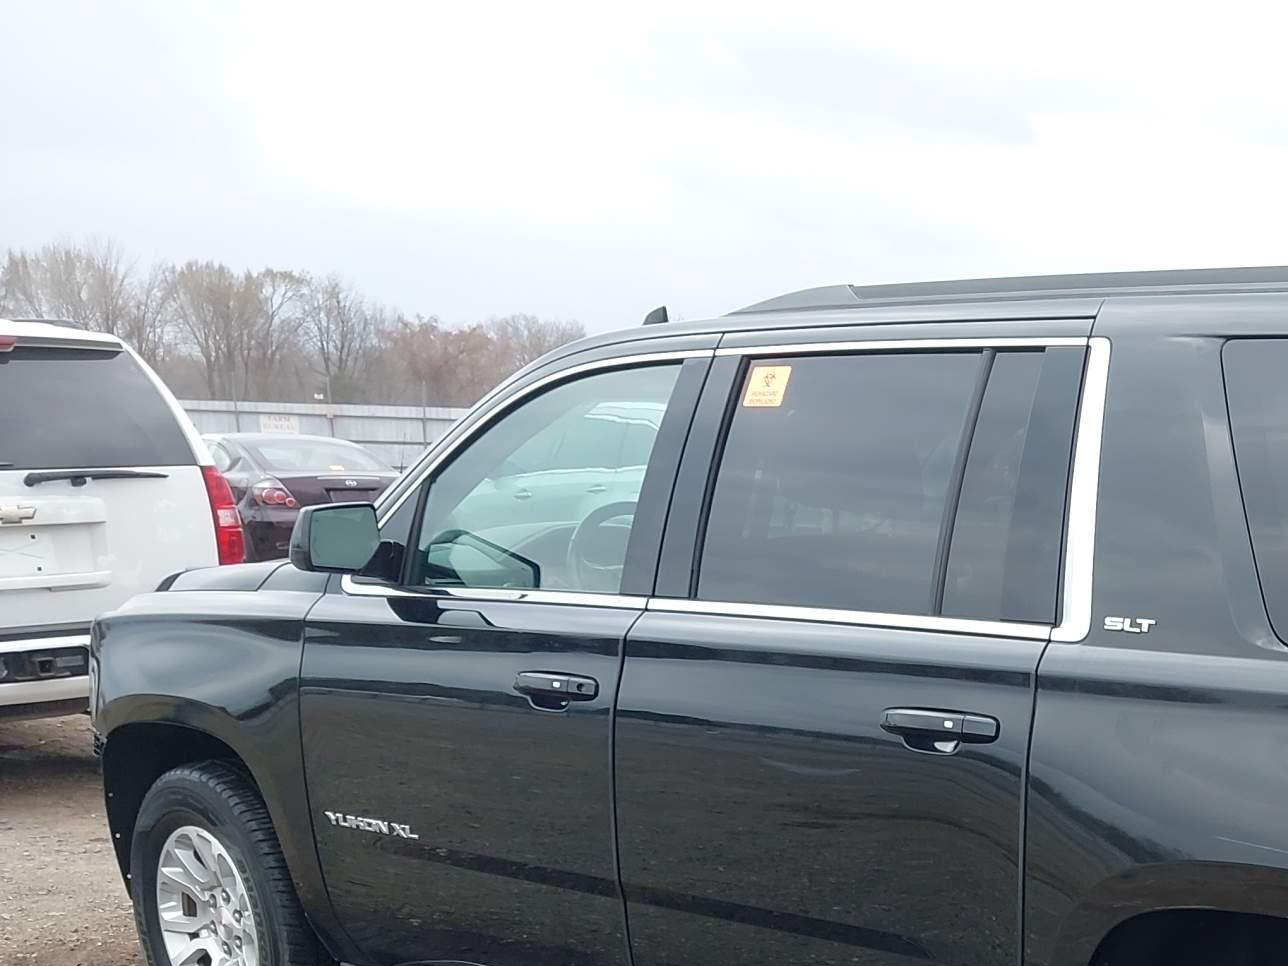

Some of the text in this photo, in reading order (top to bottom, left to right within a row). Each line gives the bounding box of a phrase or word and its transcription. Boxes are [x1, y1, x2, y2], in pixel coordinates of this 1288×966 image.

[1103, 616, 1157, 634] SLT
[324, 811, 420, 840] YUKON XL
